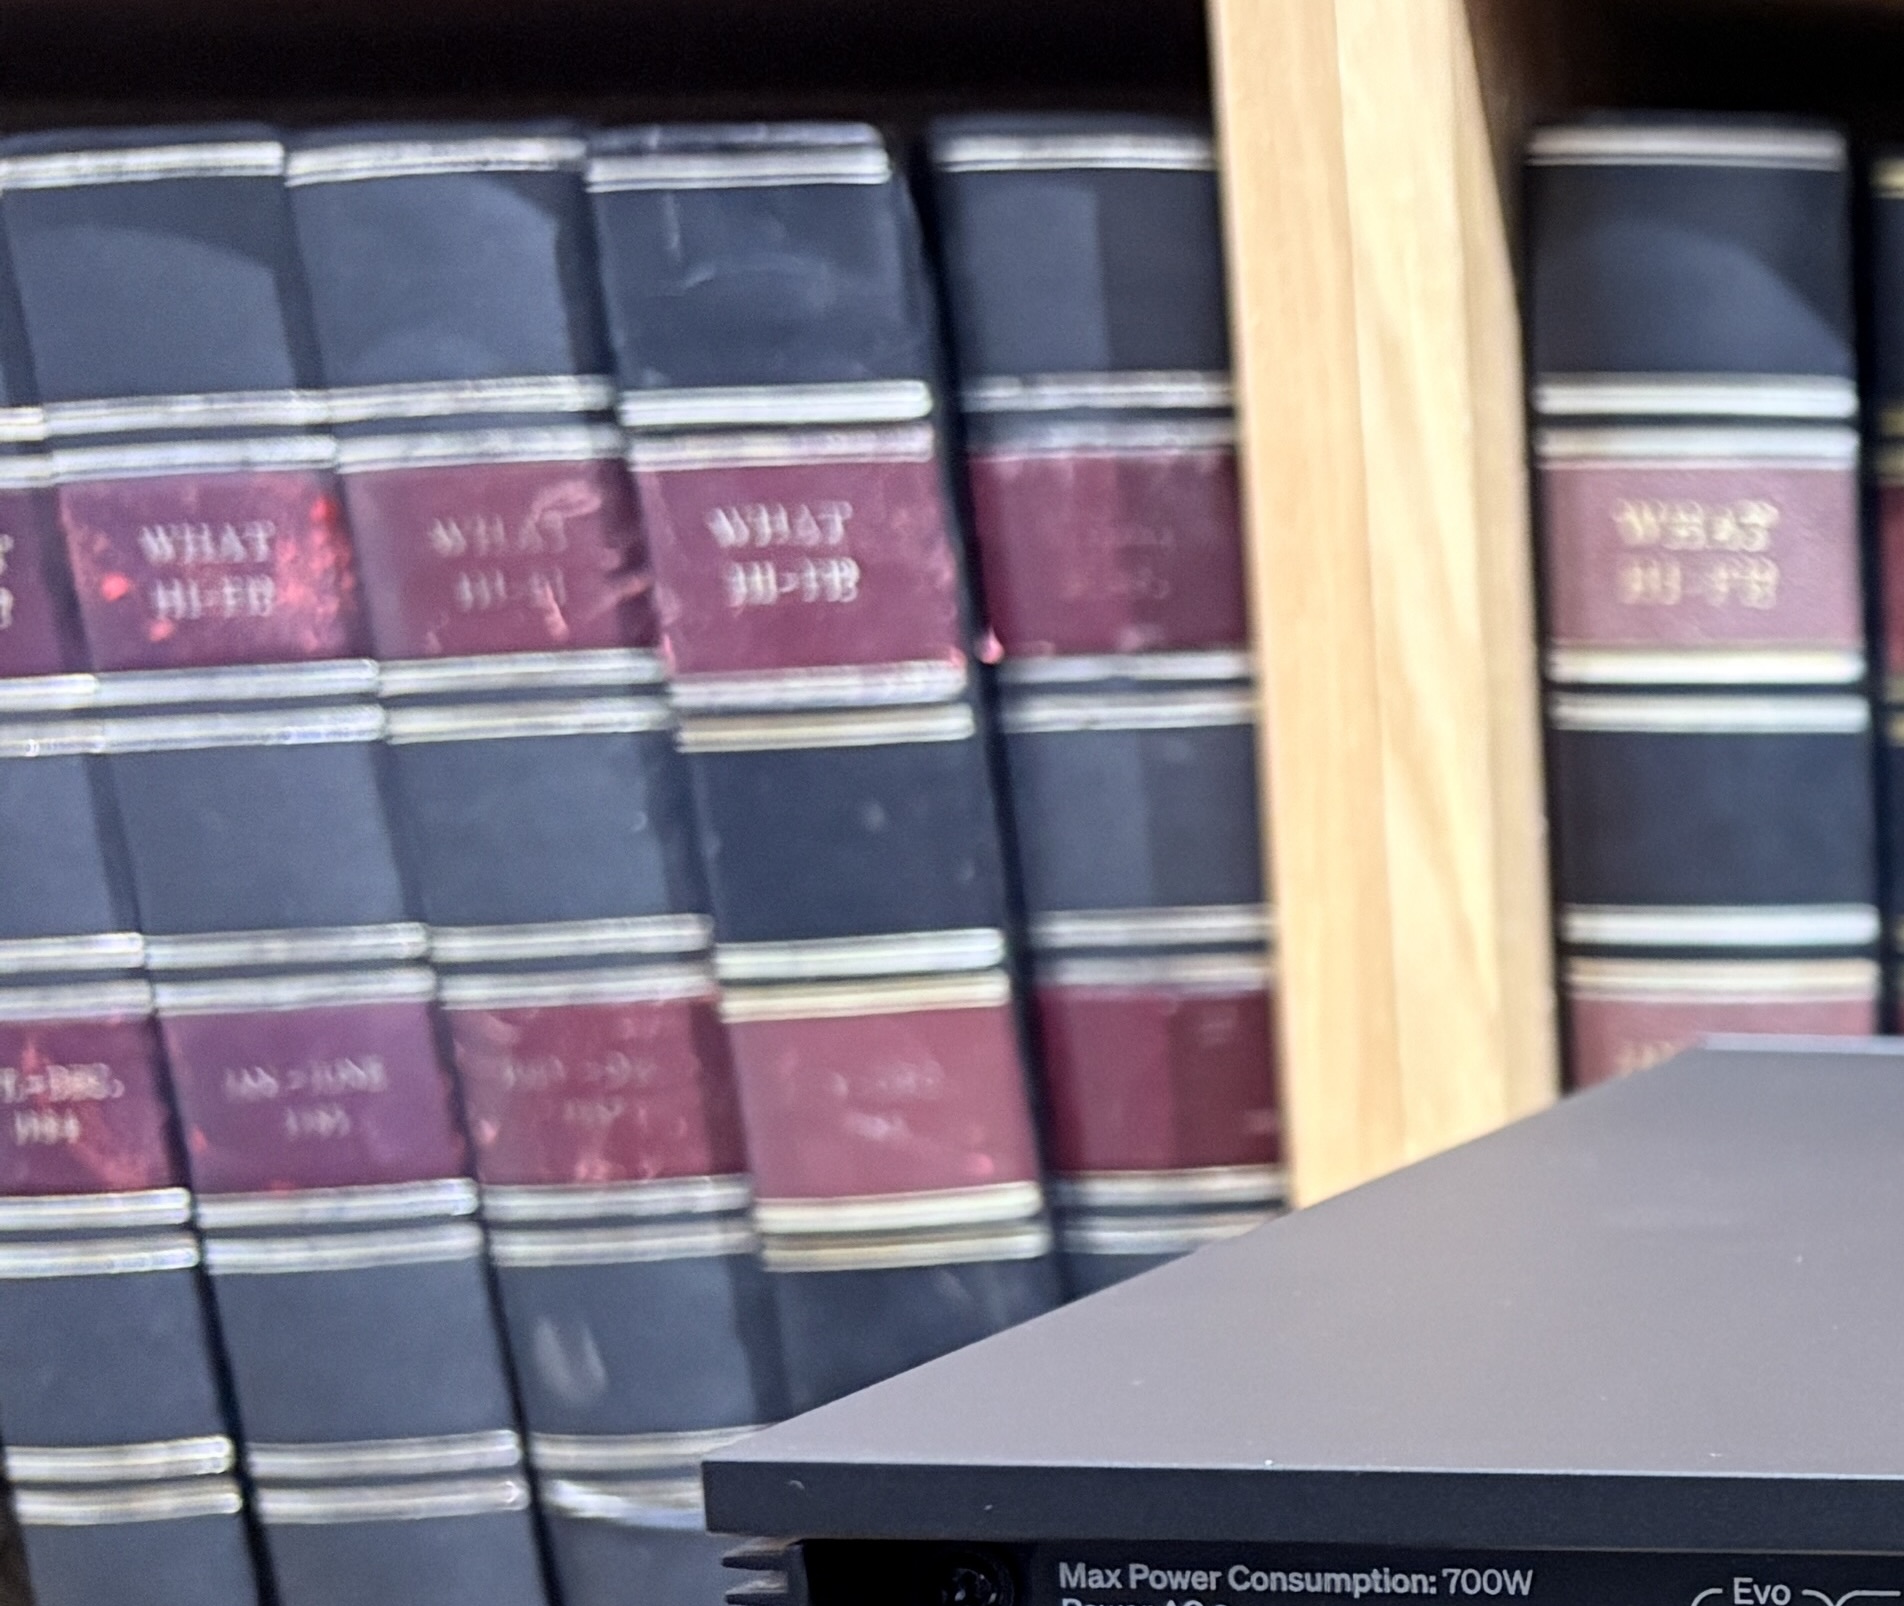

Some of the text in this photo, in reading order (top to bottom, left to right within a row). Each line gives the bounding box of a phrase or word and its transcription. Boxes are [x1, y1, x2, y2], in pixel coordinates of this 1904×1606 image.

[139, 521, 276, 564] WHAT
[705, 501, 853, 548] WHAT
[1059, 1562, 1533, 1599] Max Power Consumption: 700W
[1733, 1576, 1792, 1606] Evo
